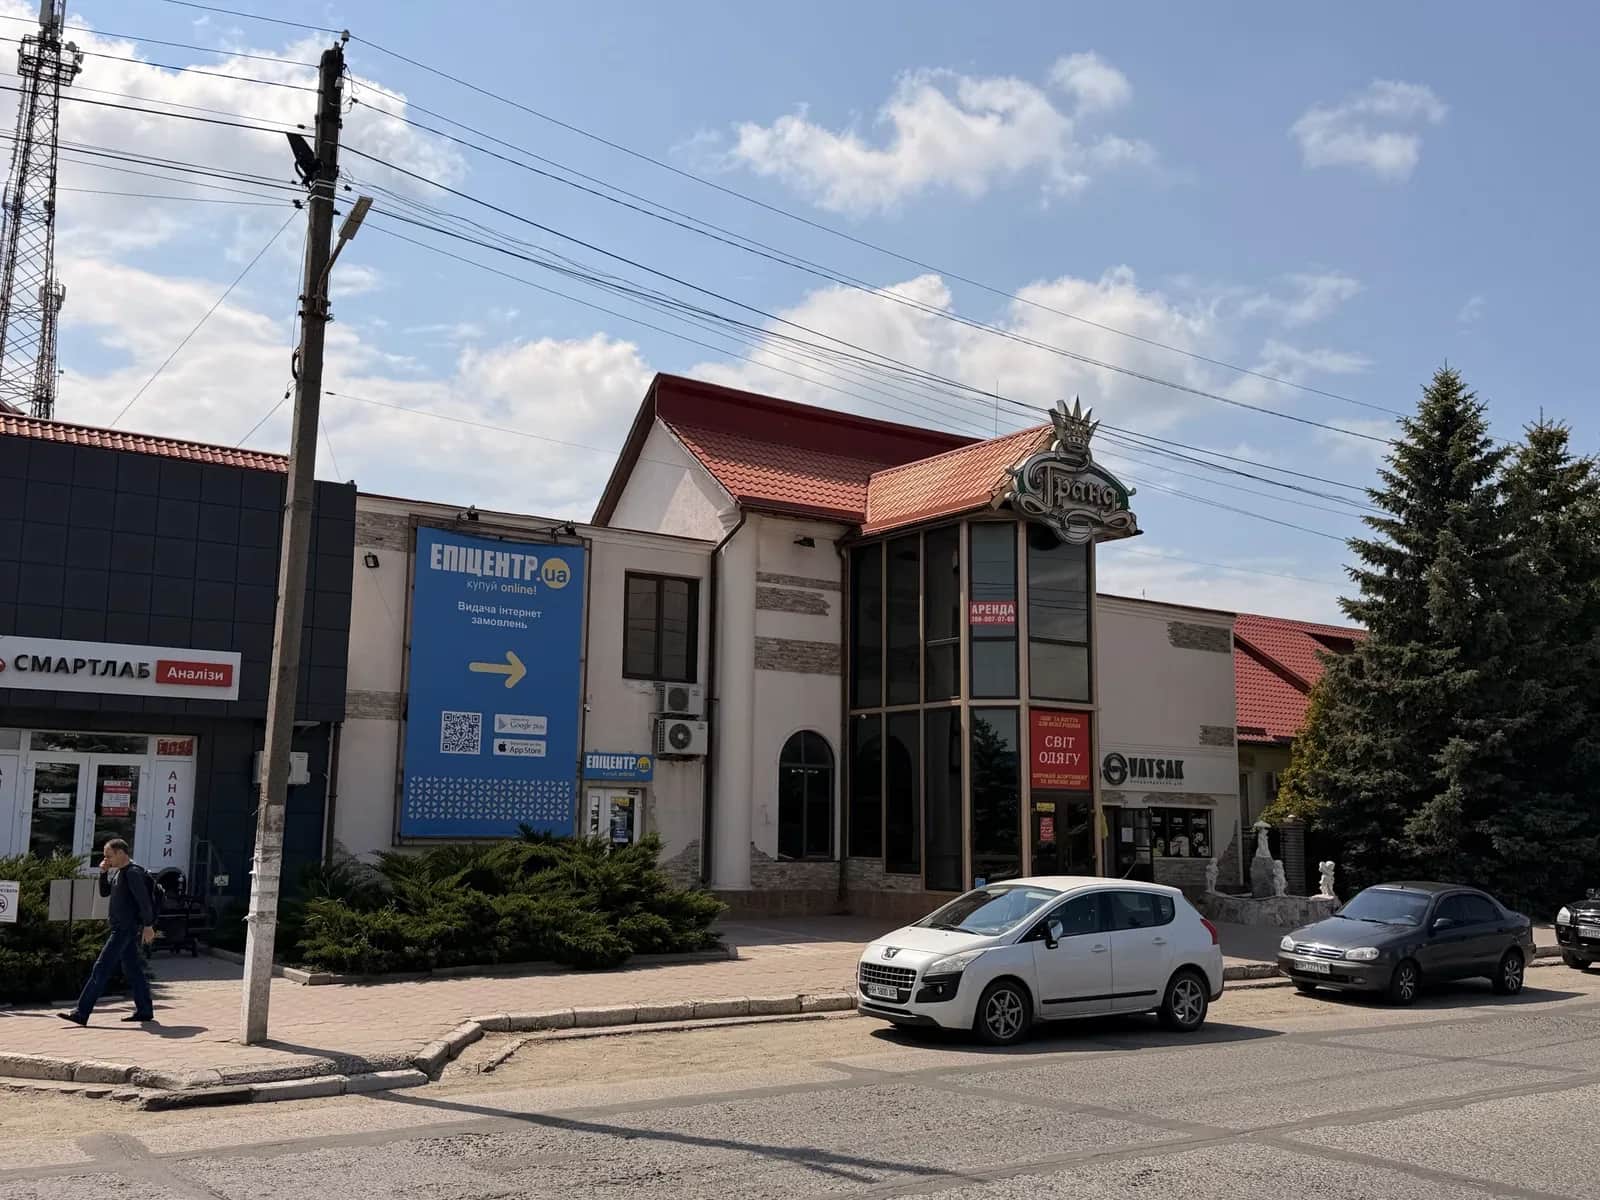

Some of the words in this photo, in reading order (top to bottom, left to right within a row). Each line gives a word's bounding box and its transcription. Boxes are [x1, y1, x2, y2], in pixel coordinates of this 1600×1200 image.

[501, 582, 537, 596] online!
[458, 601, 496, 614] Видача
[499, 605, 542, 618] інтернет
[972, 604, 1015, 616] АРЕНДА
[472, 617, 528, 629] замовлень
[14, 654, 151, 680] СМАРТЛАБ
[168, 667, 224, 682] Аналізи
[1045, 735, 1075, 748] СВІТ
[1039, 751, 1080, 766] ОДЯГУ
[1128, 758, 1184, 779] VATSAK
